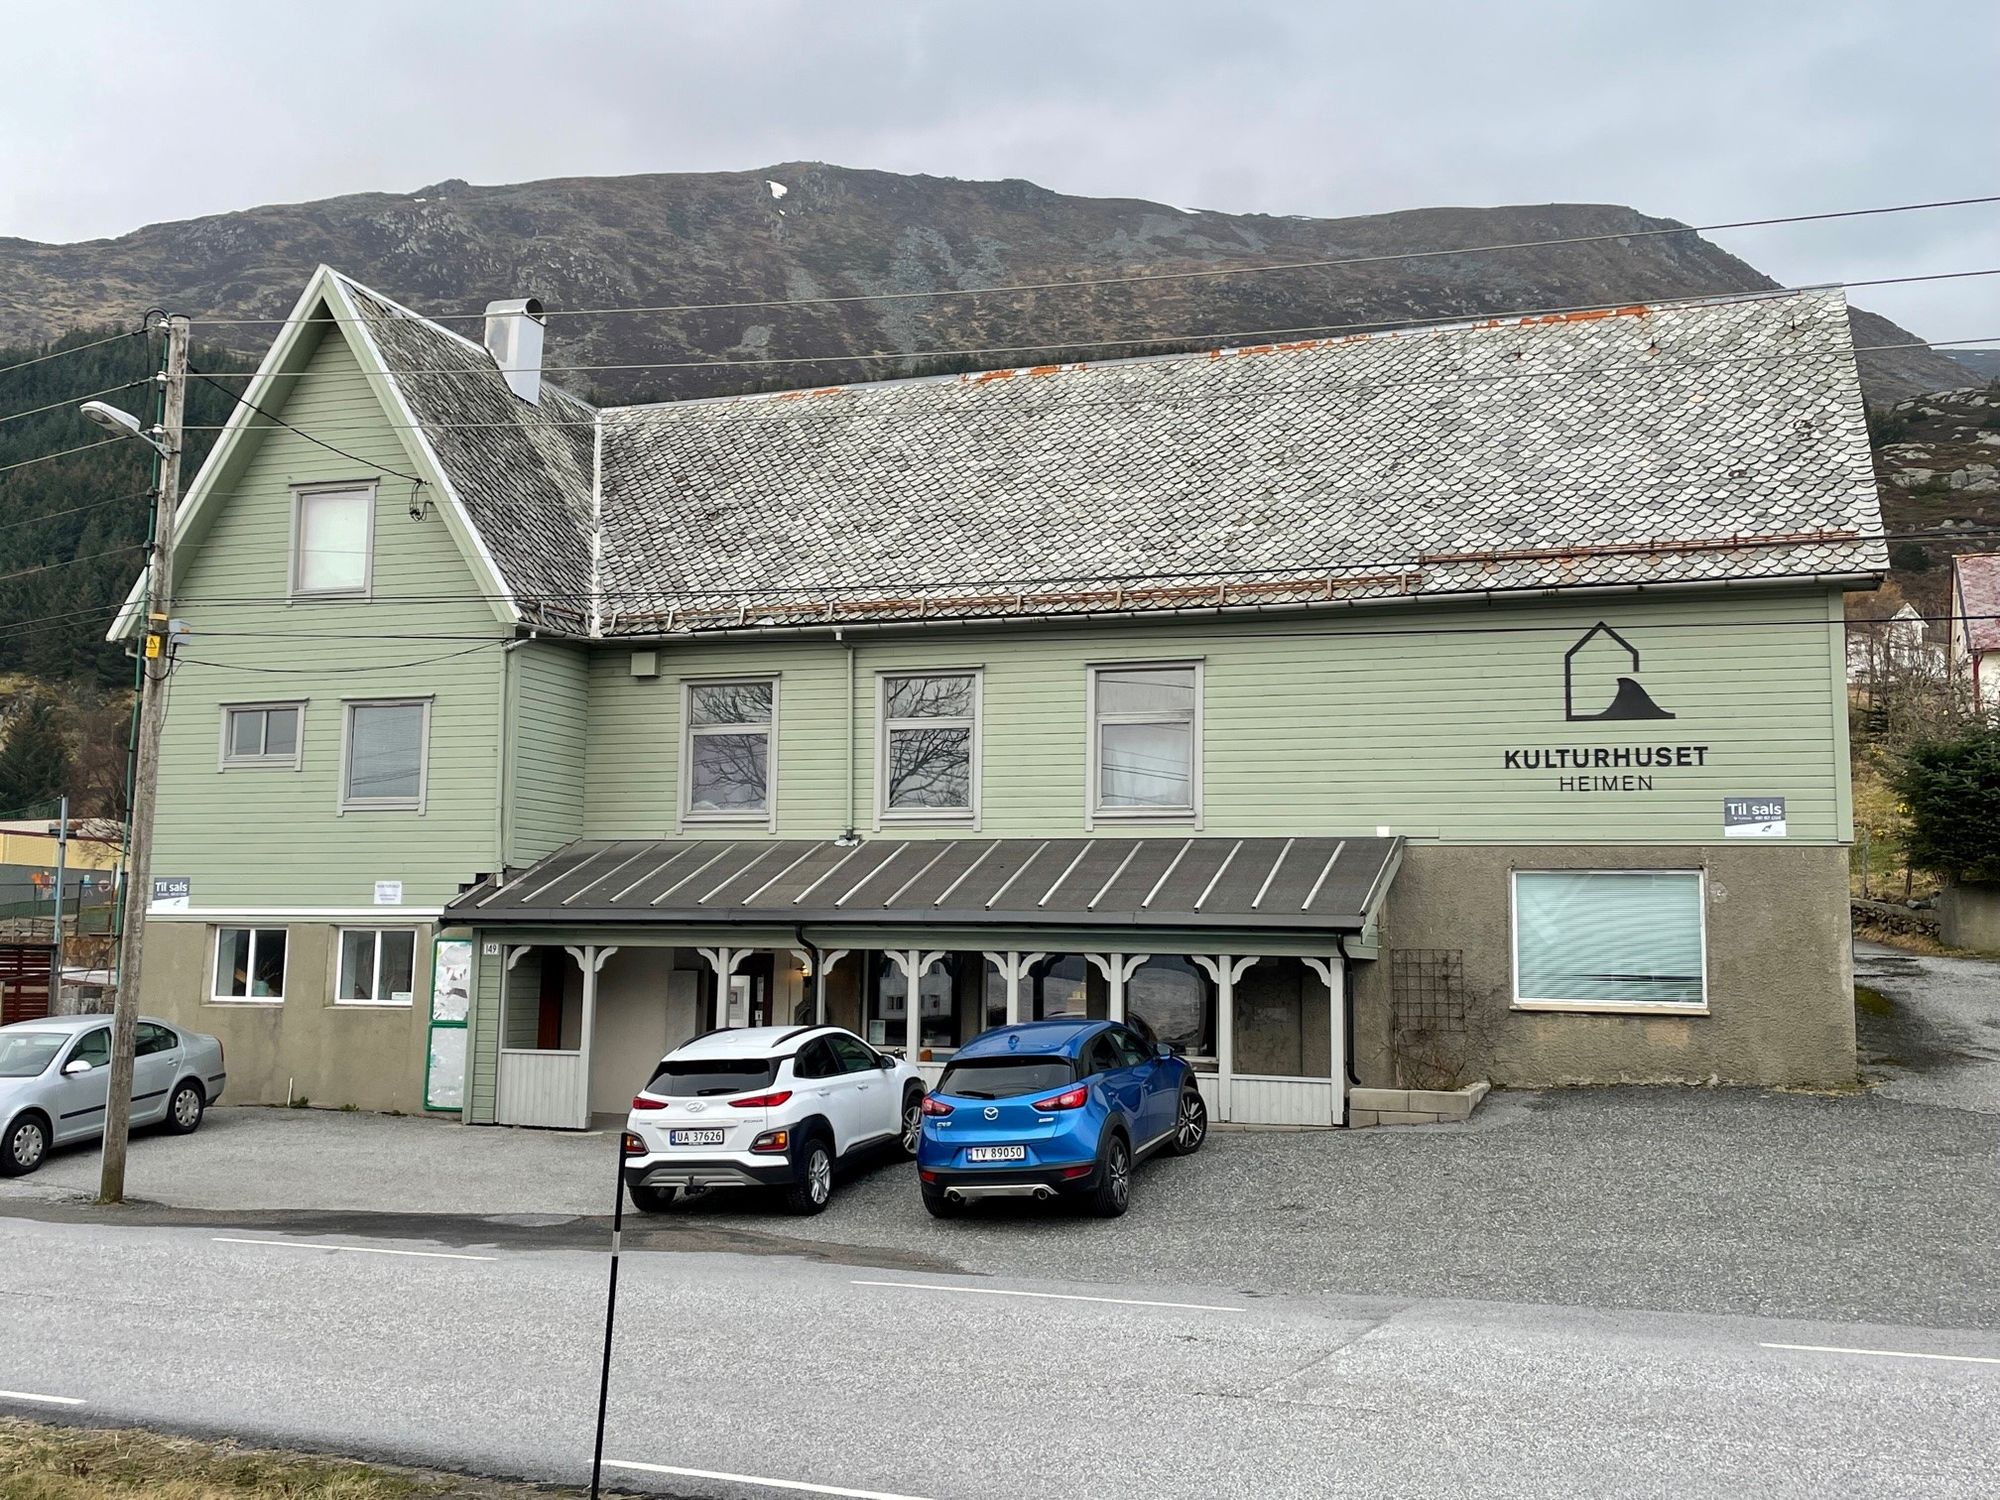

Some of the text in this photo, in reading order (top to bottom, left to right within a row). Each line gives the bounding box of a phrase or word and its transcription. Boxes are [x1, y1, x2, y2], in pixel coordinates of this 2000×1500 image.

[1504, 746, 1709, 769] KULTURHUSET
[1560, 775, 1653, 791] HEIMEN
[1728, 803, 1782, 815] Til sals
[155, 881, 188, 892] Til sals
[677, 1131, 721, 1142] UA 37626
[975, 1147, 1022, 1158] TV 89050
